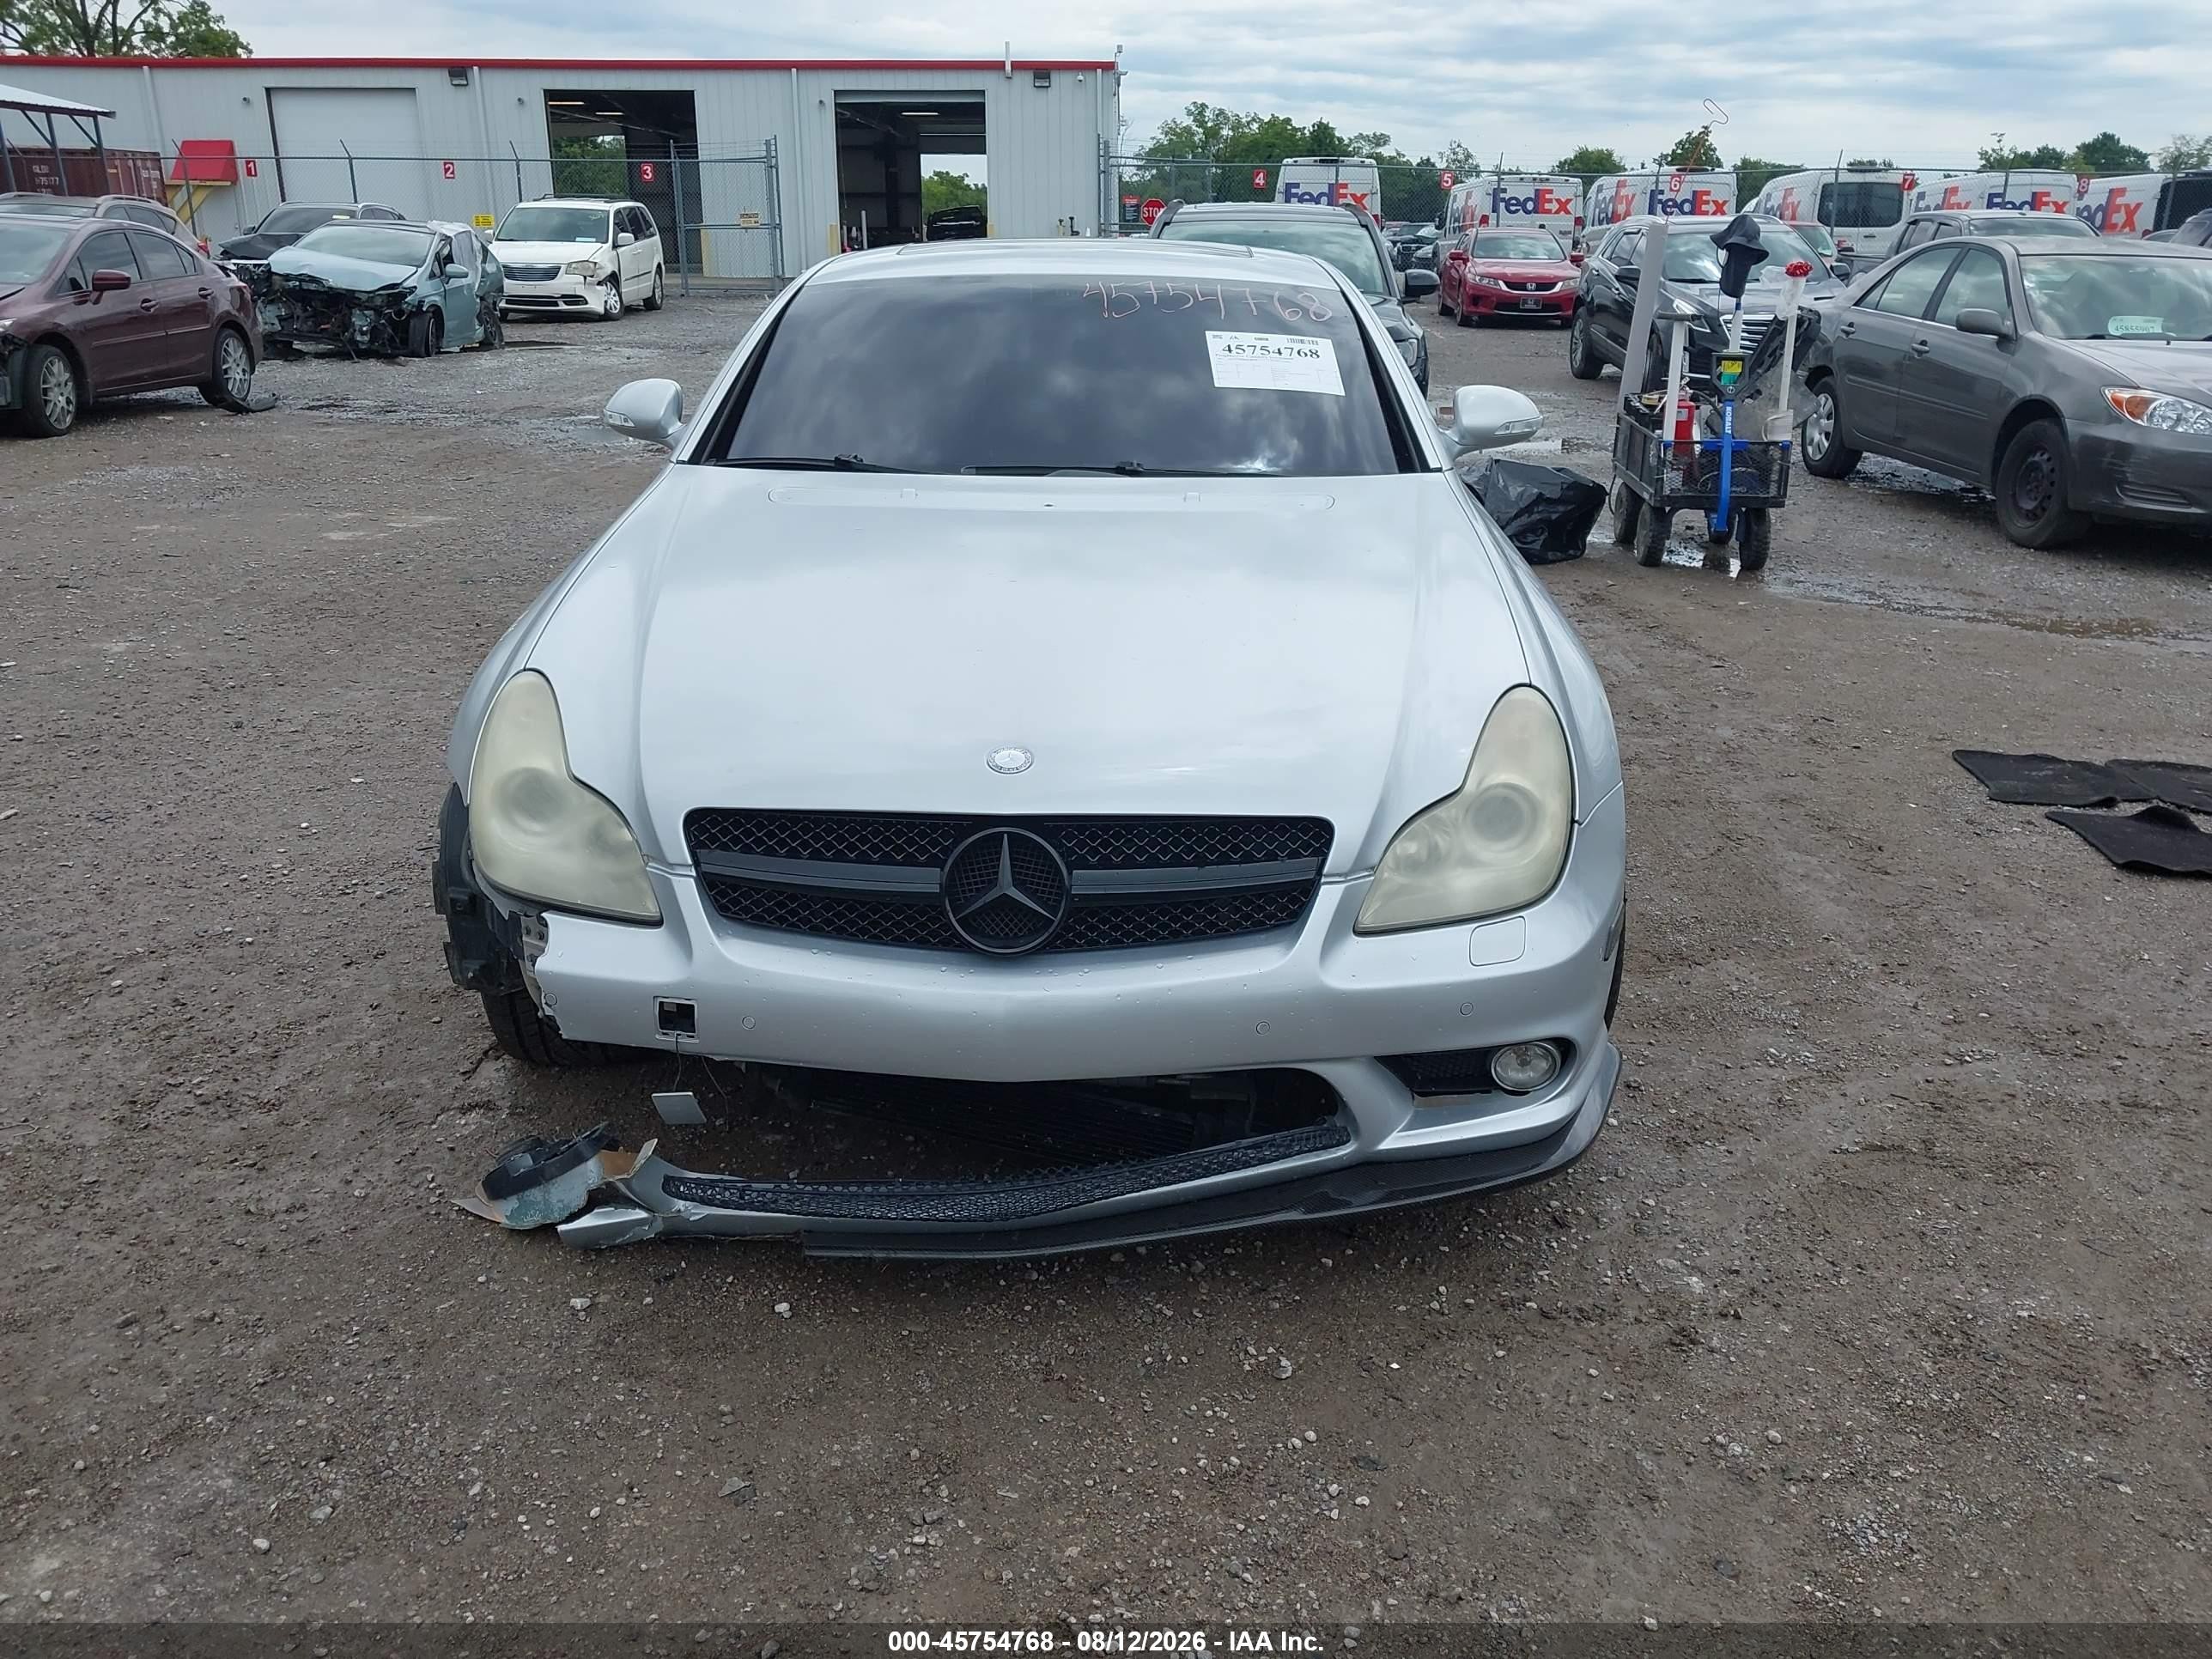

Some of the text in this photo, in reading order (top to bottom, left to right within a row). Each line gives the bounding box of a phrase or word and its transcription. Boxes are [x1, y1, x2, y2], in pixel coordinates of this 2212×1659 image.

[248, 161, 256, 176] 1
[444, 163, 454, 178] 2
[642, 165, 653, 179] 3
[1255, 172, 1265, 186] 4
[1443, 173, 1452, 187] 5
[1670, 177, 1680, 191] 6
[1903, 175, 1912, 189] 7
[2078, 178, 2089, 192] 8
[1285, 182, 1370, 210] FedEx
[1492, 187, 1574, 216] FedEx
[1591, 179, 1636, 227] FedEx
[1648, 189, 1730, 216] FedEx
[1143, 207, 1164, 218] STO
[1083, 281, 1332, 322] 45754768
[1222, 343, 1321, 359] 45754768
